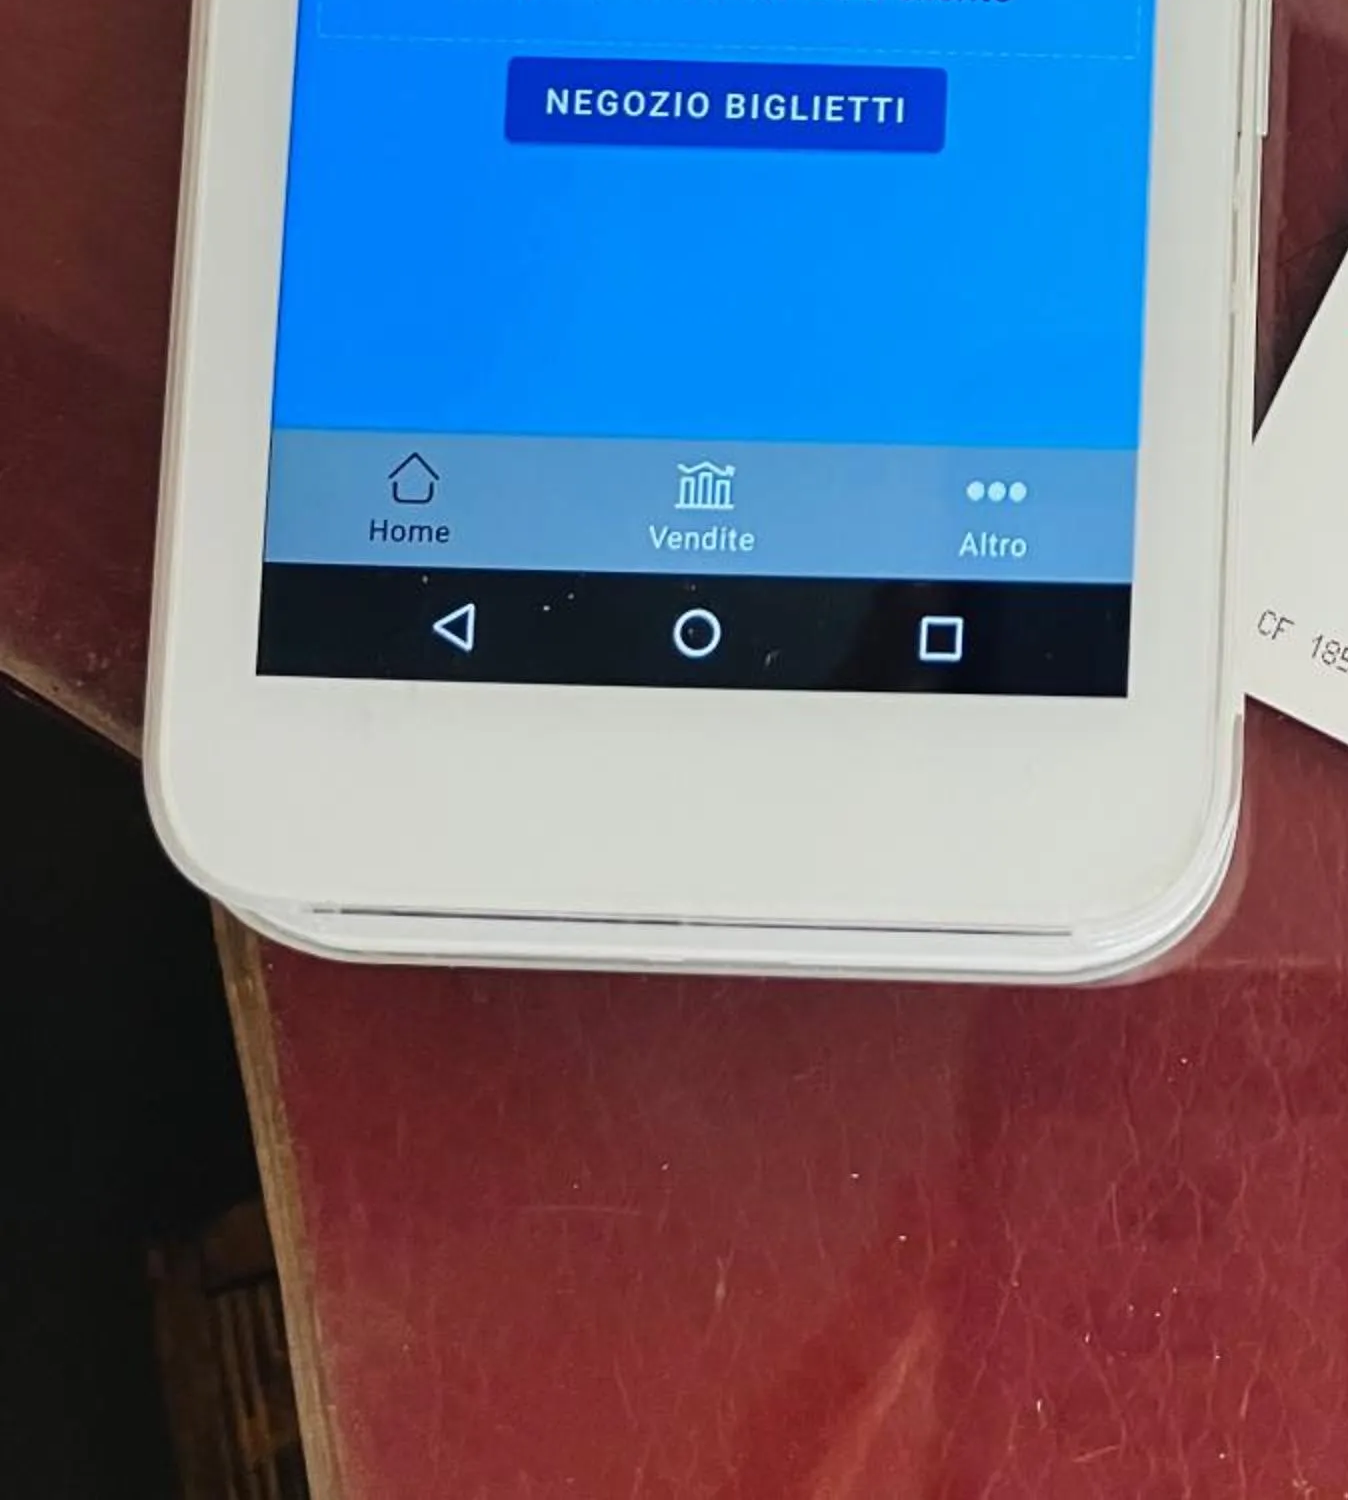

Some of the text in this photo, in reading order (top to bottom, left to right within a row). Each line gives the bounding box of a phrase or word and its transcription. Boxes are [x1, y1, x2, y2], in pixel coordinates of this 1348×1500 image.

[545, 88, 906, 125] NEGOZIO BIGLIETTI
[369, 519, 1029, 559] Home Vendite Altro
[1257, 608, 1295, 640] CF
